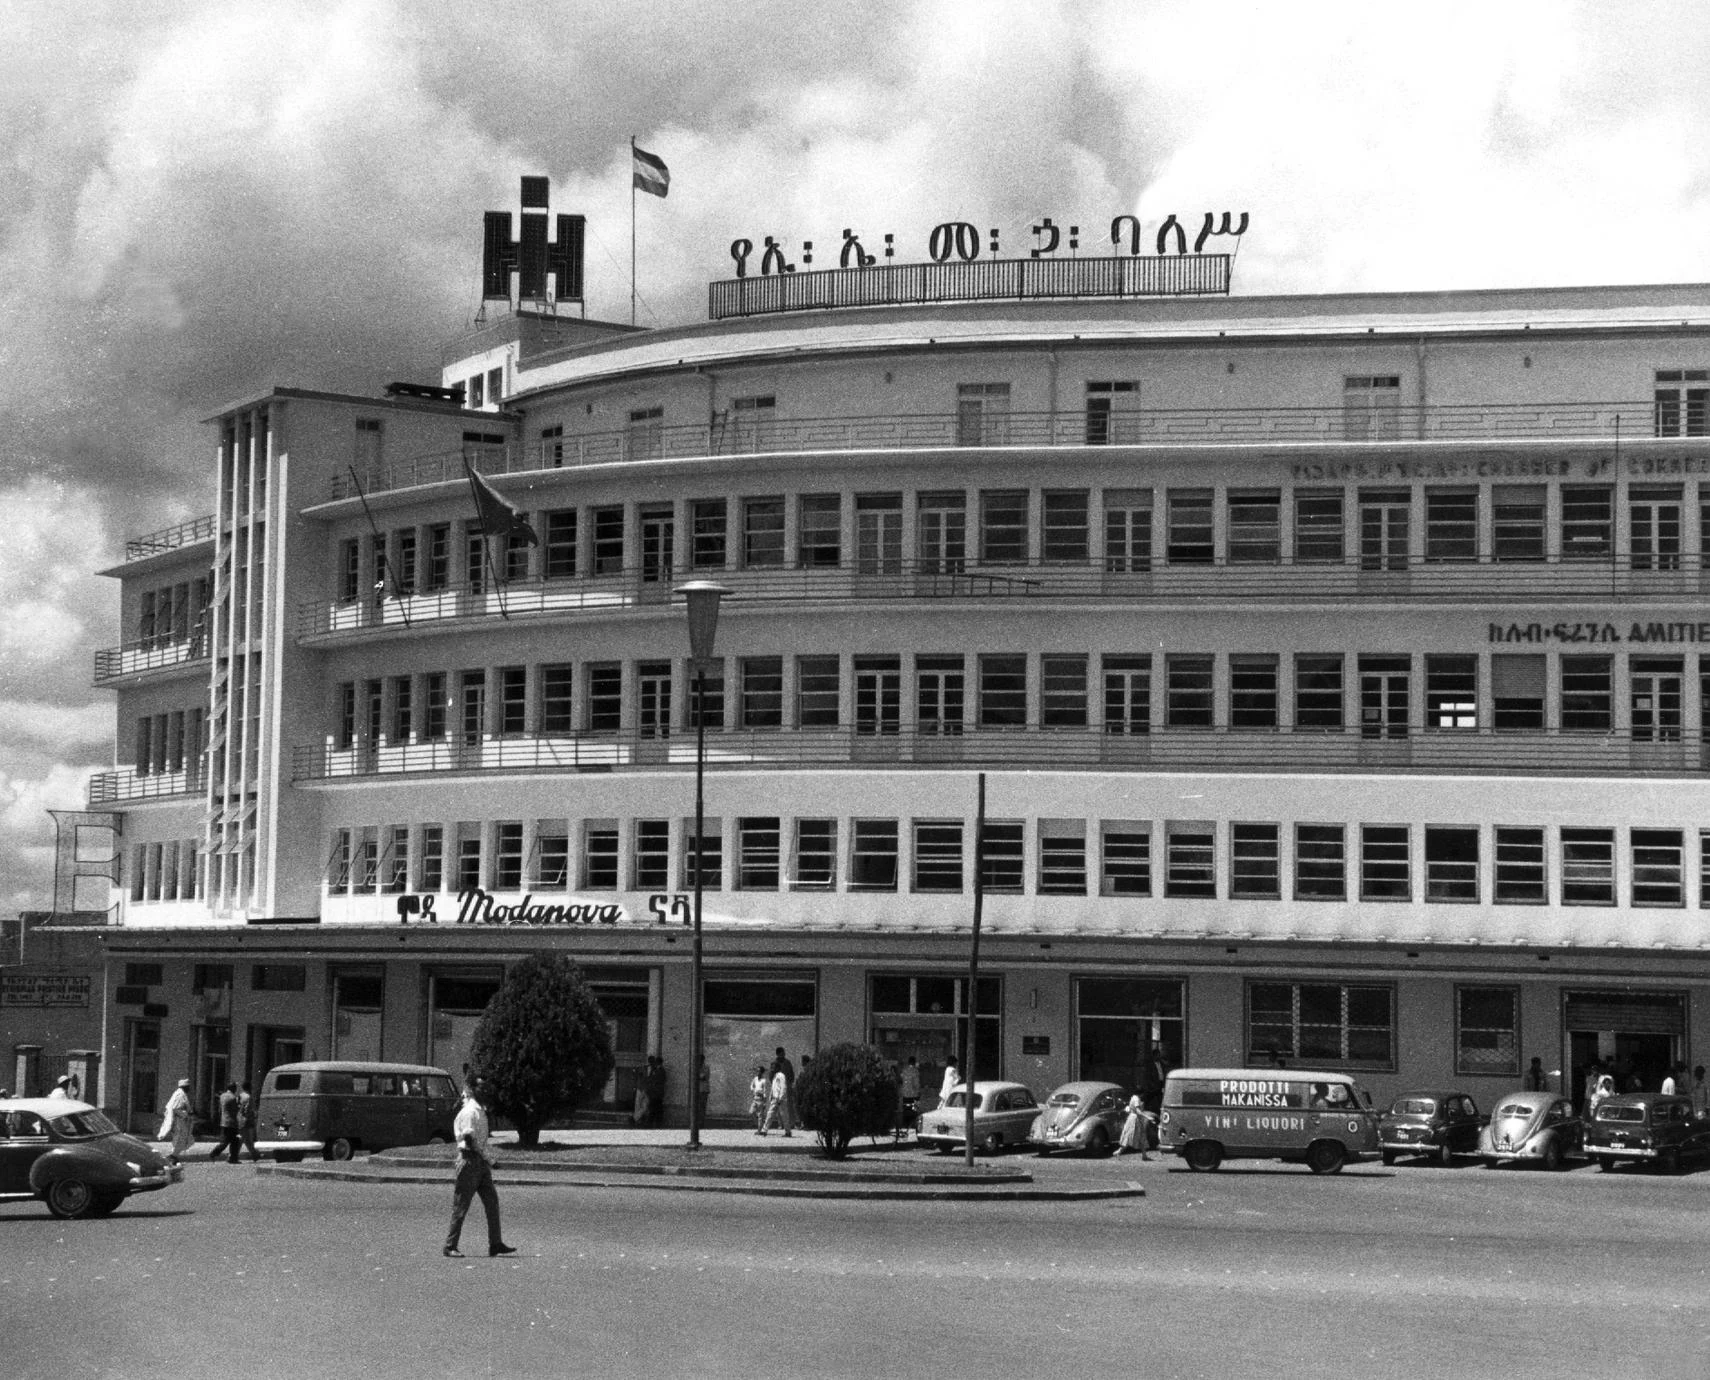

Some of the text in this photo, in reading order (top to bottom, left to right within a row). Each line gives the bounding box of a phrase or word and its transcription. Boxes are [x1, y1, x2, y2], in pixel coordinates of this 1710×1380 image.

[457, 887, 622, 923] Modanova
[1220, 1080, 1289, 1094] PRODOTTI
[1222, 1093, 1288, 1107] MAKANISSA
[1246, 1117, 1304, 1130] LIQUORI
